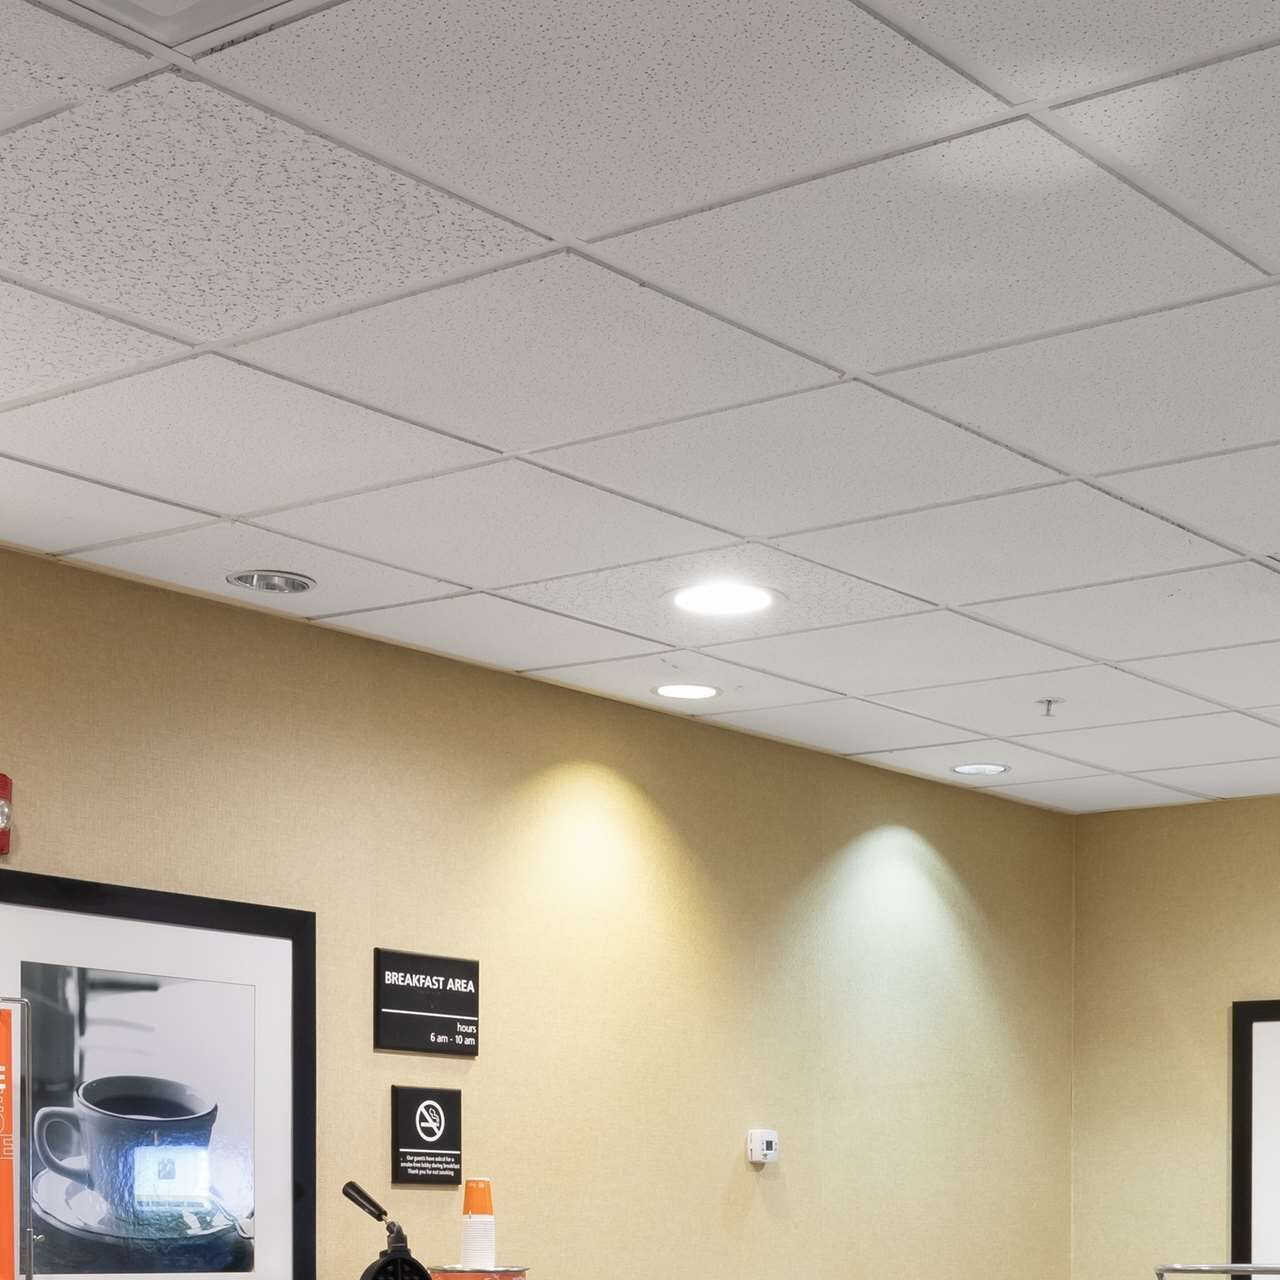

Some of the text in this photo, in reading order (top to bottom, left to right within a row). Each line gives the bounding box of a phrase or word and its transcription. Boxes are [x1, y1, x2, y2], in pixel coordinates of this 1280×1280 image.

[385, 971, 475, 993] BREAKFAST AREA
[457, 1022, 476, 1033] hours
[430, 1033, 436, 1042] 6
[437, 1035, 448, 1044] am
[455, 1034, 463, 1045] 10
[464, 1036, 476, 1045] am
